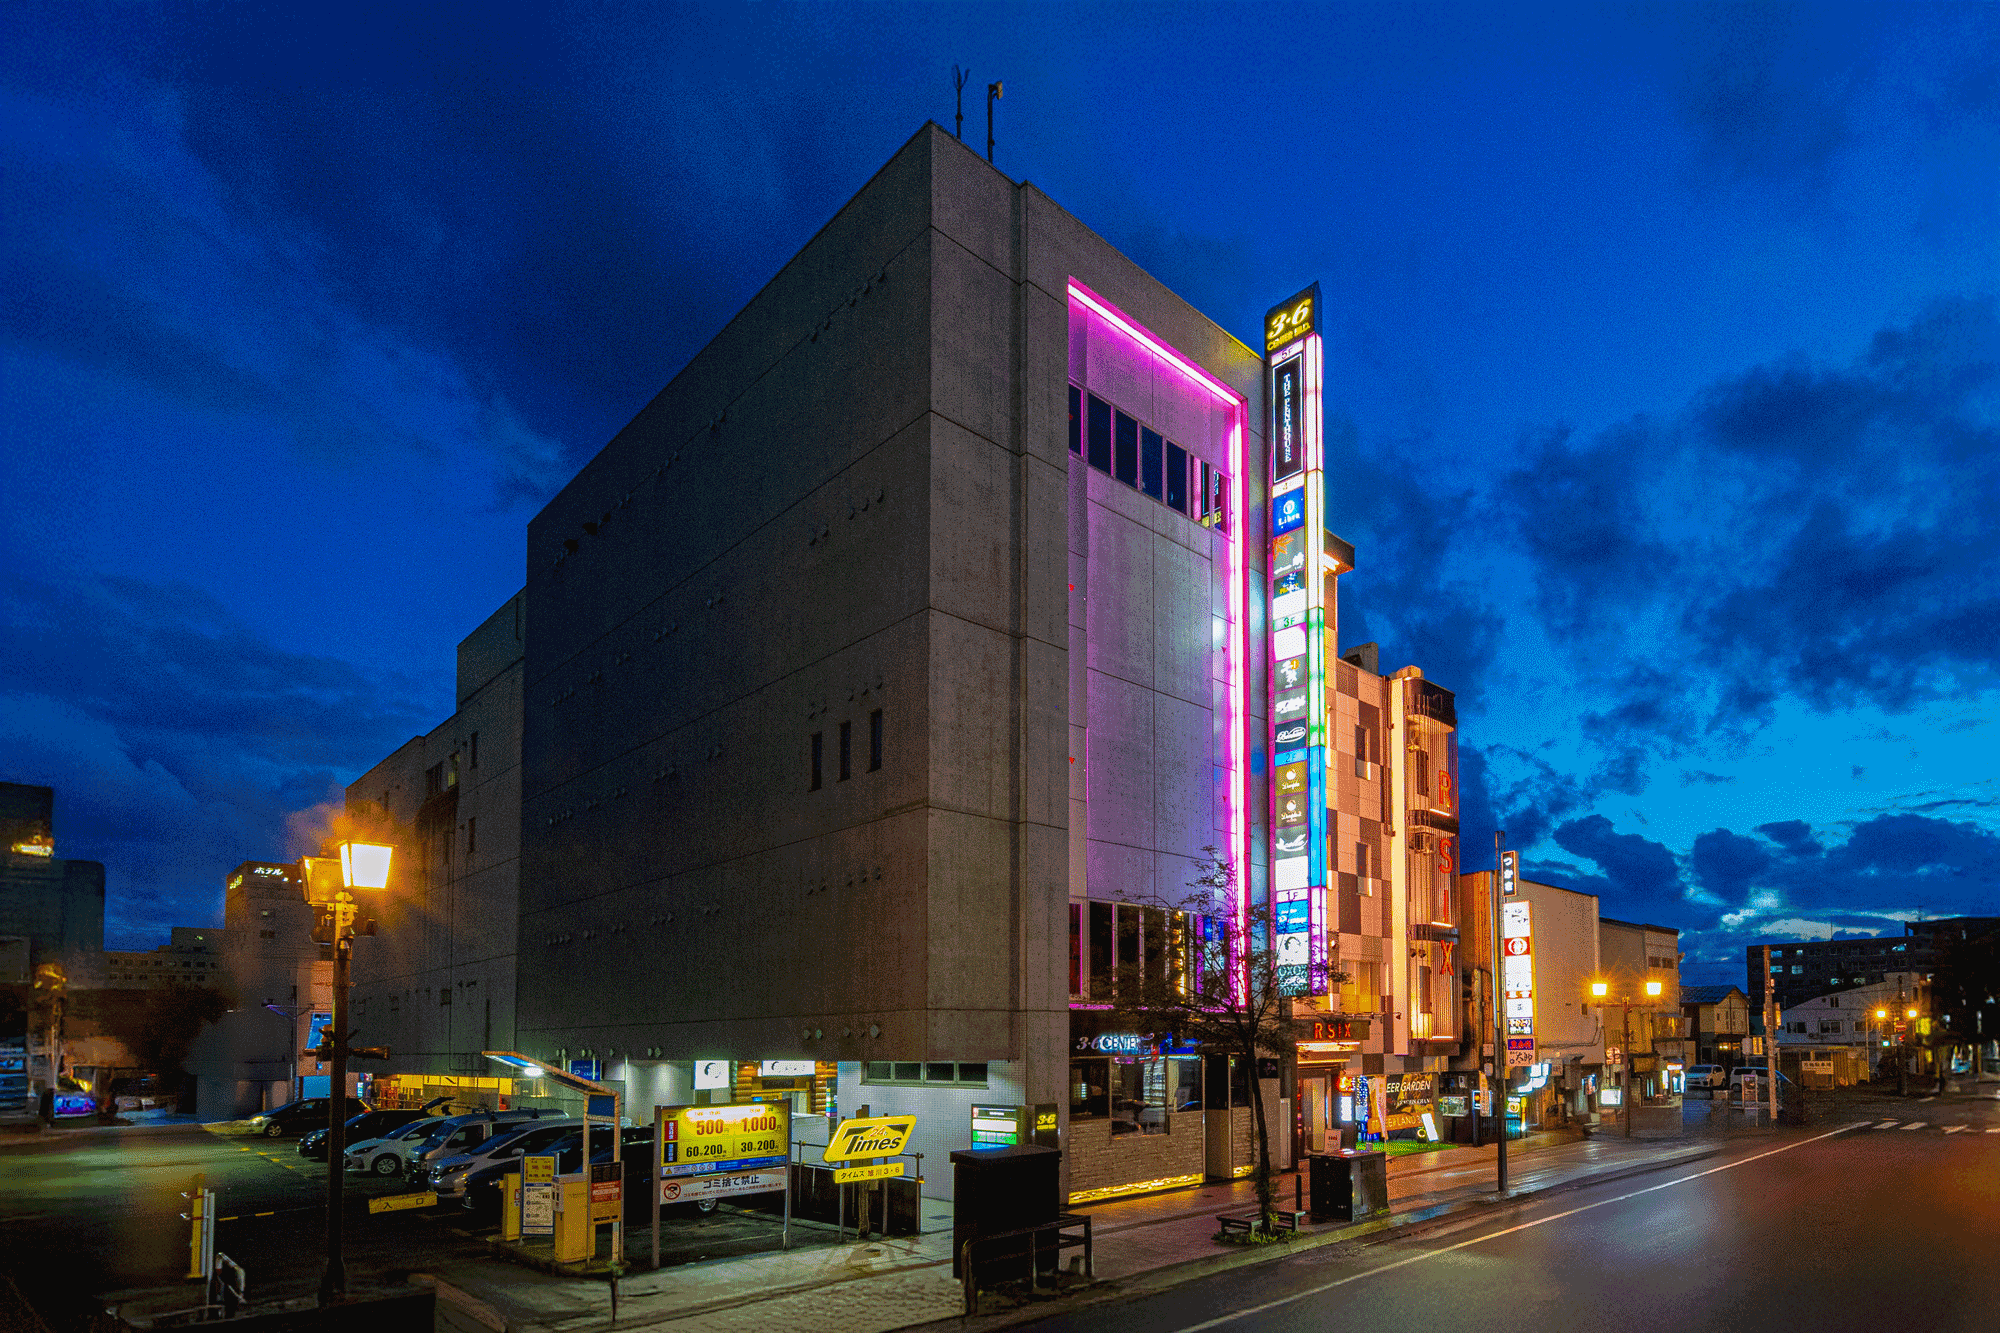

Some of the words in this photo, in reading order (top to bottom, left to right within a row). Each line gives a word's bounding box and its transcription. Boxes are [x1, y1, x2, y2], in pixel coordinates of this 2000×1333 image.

[1283, 616, 1296, 628] 3F
[1386, 1082, 1400, 1093] EER
[1401, 1081, 1431, 1091] GARDEN
[844, 1135, 902, 1155] Times
[703, 1175, 759, 1189] ゴミ捨て禁止
